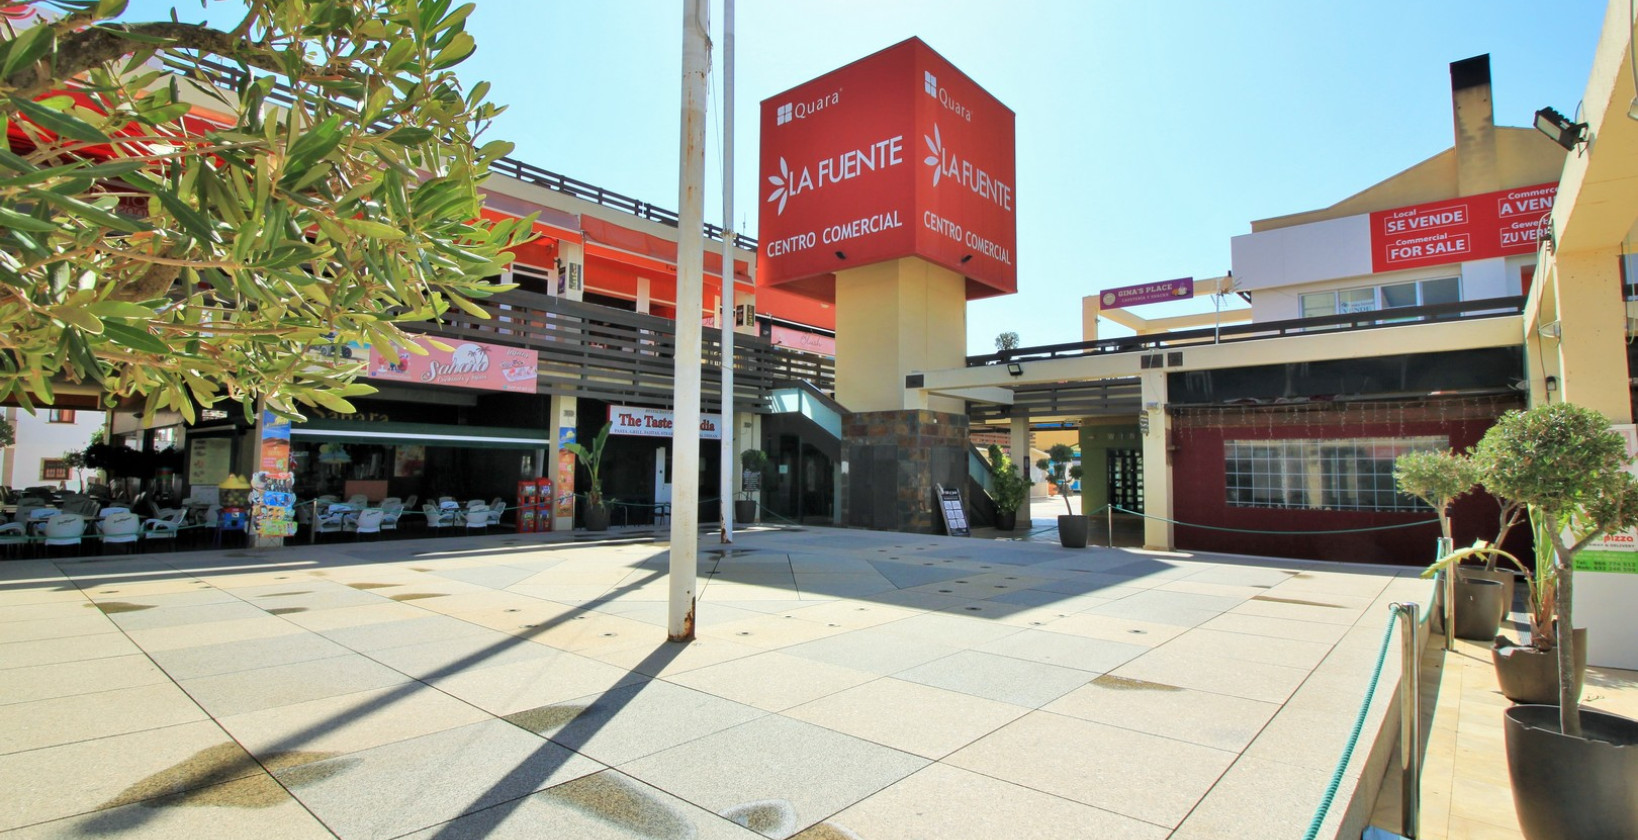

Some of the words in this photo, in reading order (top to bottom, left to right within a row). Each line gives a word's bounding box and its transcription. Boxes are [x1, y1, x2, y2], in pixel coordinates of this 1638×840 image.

[795, 92, 840, 119] Quara
[939, 87, 972, 122] Quara
[789, 166, 815, 196] LA
[818, 135, 903, 187] FUENTE
[941, 147, 961, 183] LA
[962, 159, 1011, 212] FUENTE
[1507, 186, 1558, 200] Commerc
[1393, 208, 1417, 219] Local
[1501, 203, 1513, 215] A
[1516, 196, 1555, 212] VEN
[1387, 220, 1405, 233] SE
[1408, 211, 1463, 228] VENDE
[767, 232, 816, 258] CENTRO
[822, 210, 903, 244] COMERCIAL
[924, 210, 962, 241] CENTRO
[965, 232, 1011, 265] COMERCIAL
[1395, 232, 1448, 246] Commercial
[1502, 232, 1518, 244] ZU
[1390, 246, 1422, 260] FOR
[1425, 240, 1466, 256] SALE
[1118, 287, 1144, 297] GINA'S
[1145, 283, 1173, 294] PLACE
[421, 356, 489, 383] Sahara
[619, 413, 642, 427] The
[644, 415, 673, 429] Taste
[700, 419, 715, 431] dia
